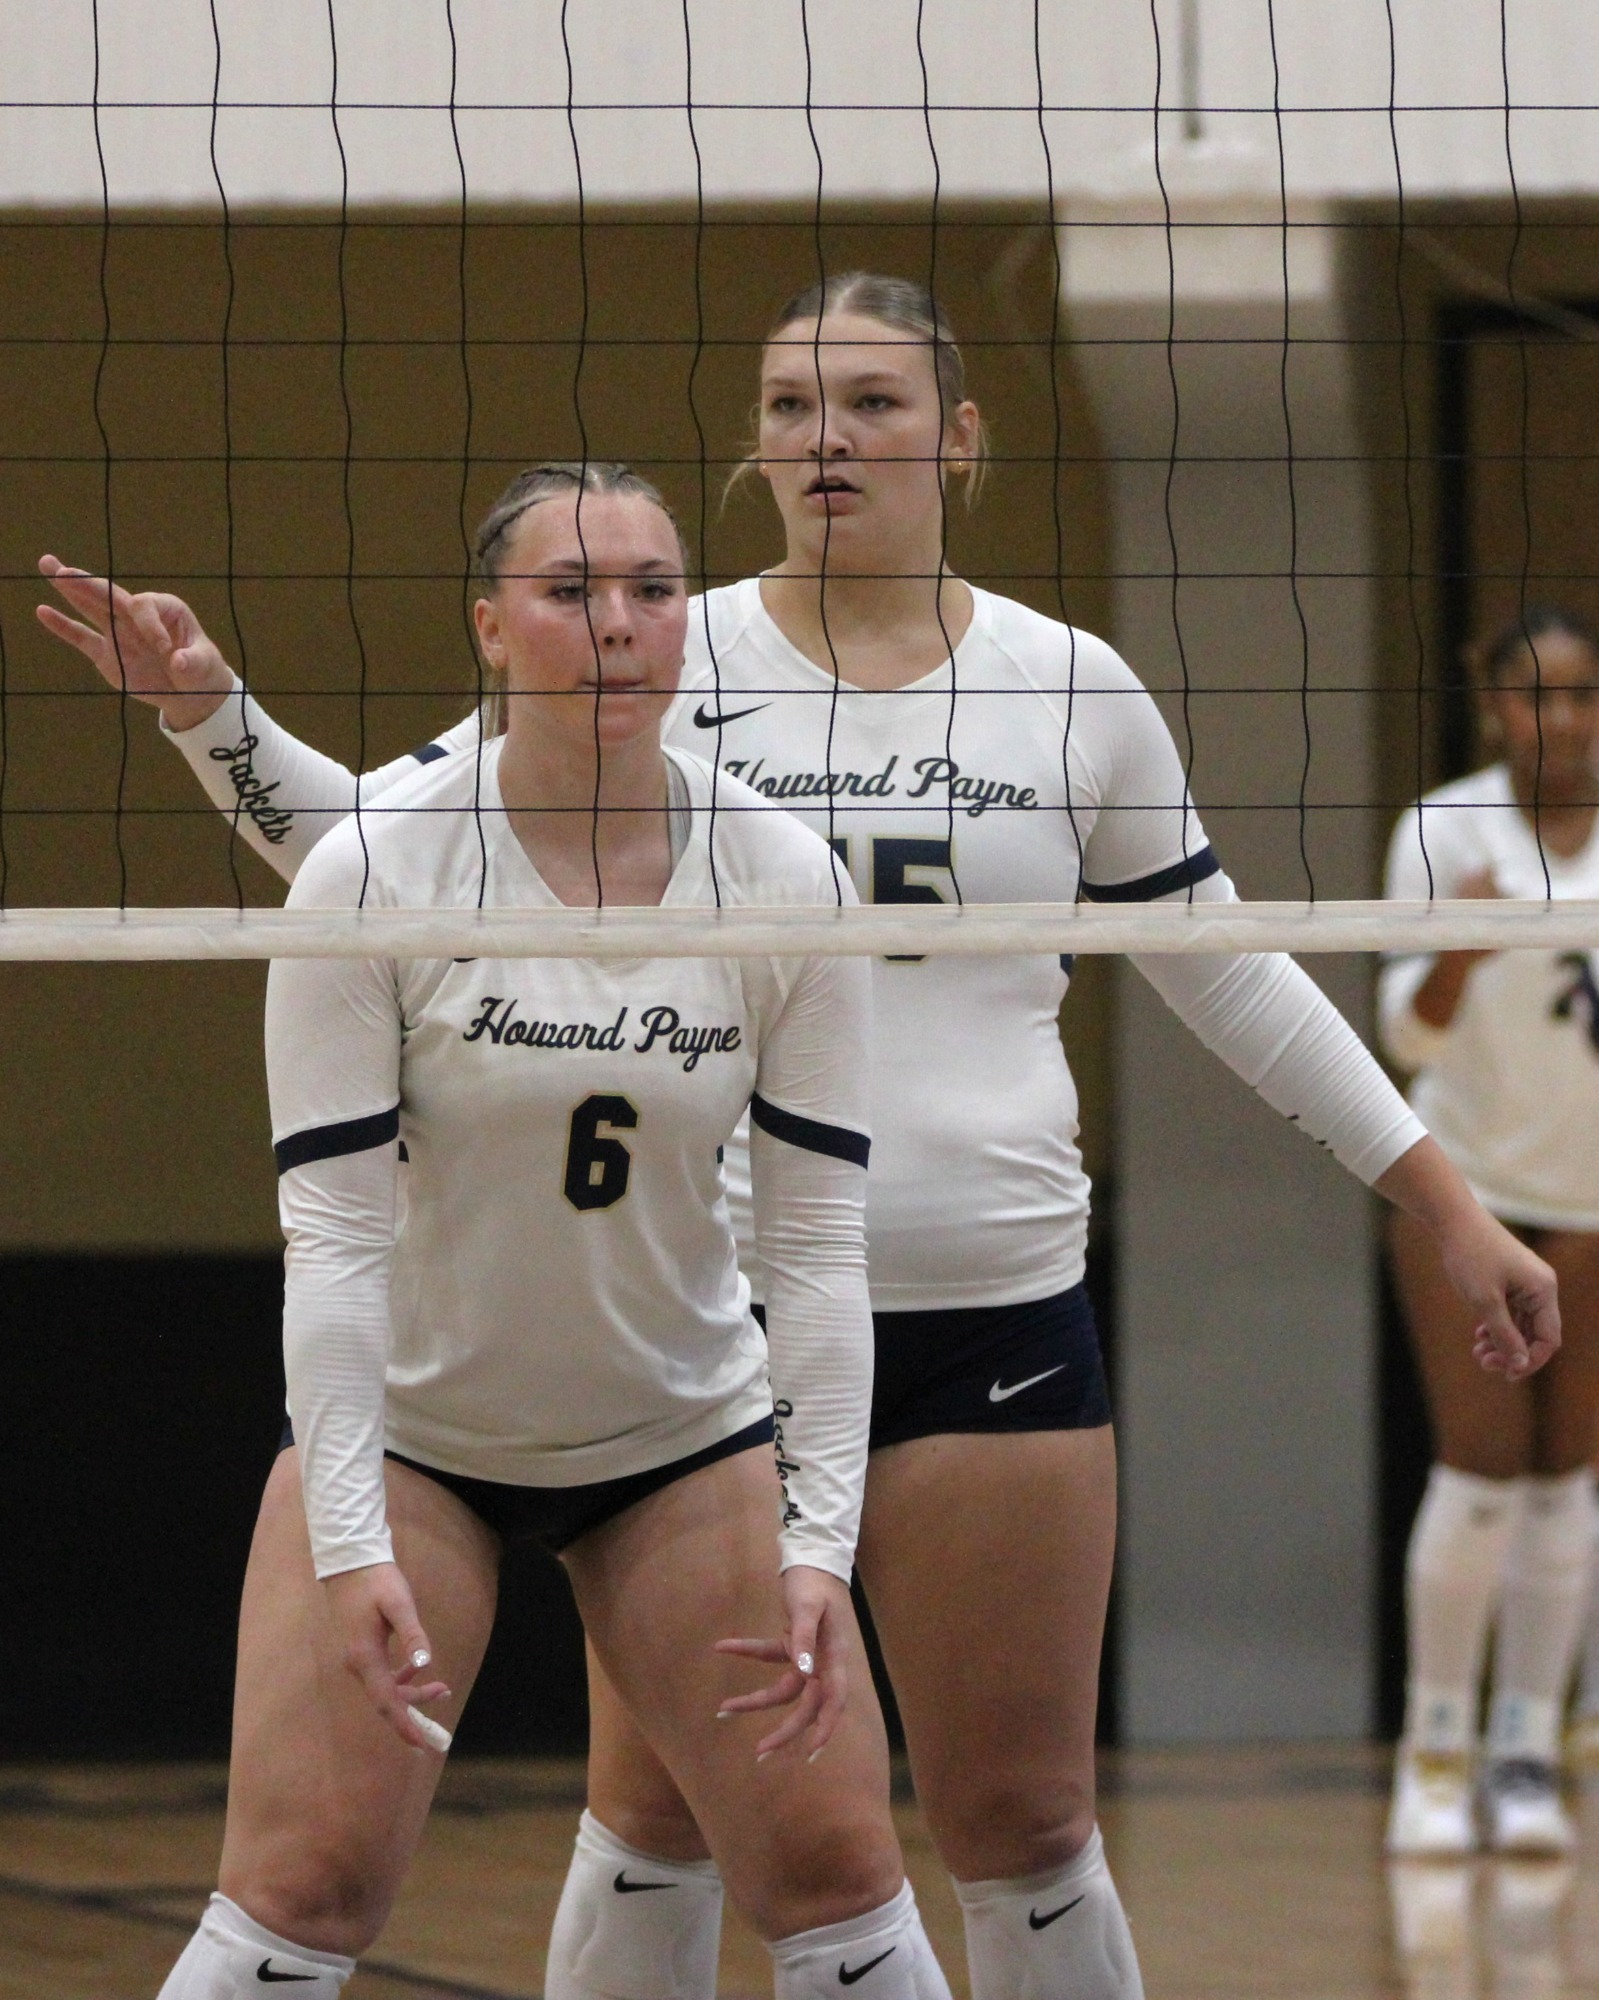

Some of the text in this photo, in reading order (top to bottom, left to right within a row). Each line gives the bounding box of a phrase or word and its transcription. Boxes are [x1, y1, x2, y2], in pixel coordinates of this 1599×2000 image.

[907, 757, 1037, 817] Payne
[826, 833, 956, 965] 5
[463, 996, 742, 1073] Howard Payne
[563, 1089, 641, 1214] 6
